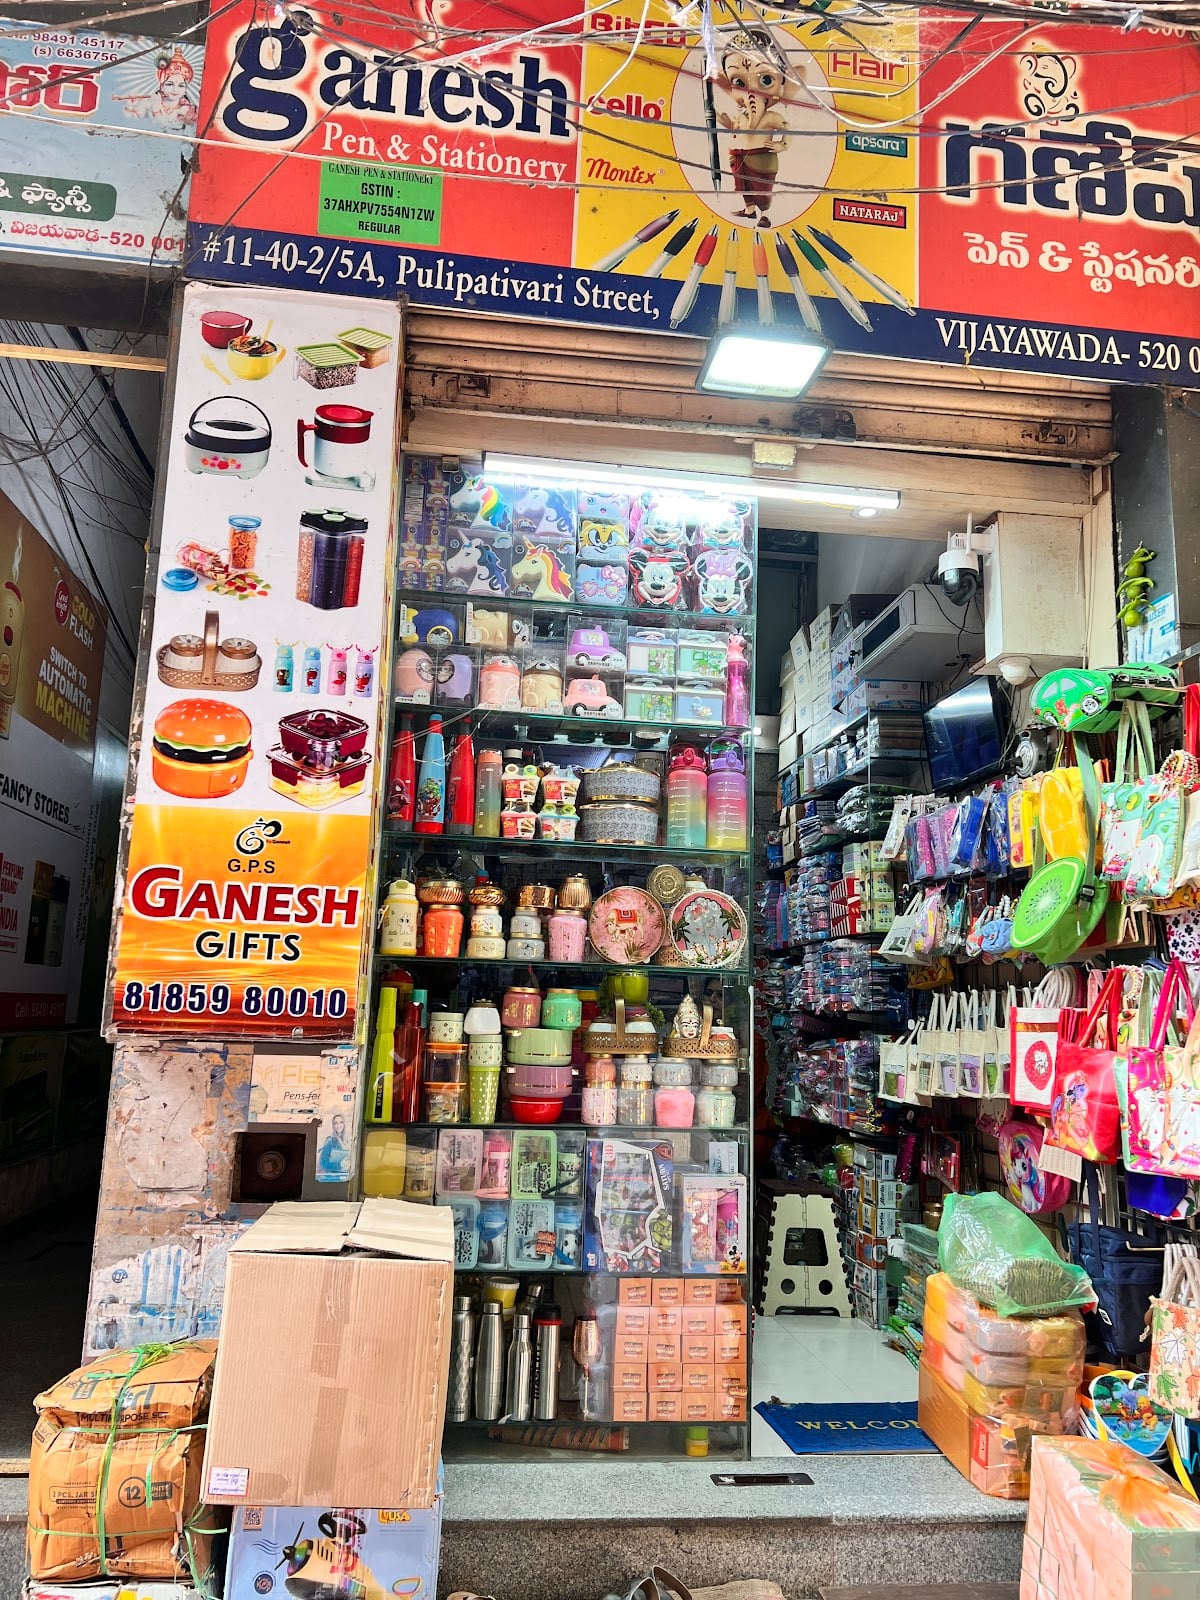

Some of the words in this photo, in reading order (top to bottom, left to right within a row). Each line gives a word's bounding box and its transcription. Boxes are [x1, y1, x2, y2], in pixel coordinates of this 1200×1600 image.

[32, 33, 75, 45] 98491
[80, 37, 125, 49] 45117
[57, 48, 118, 62] 6636756
[223, 10, 570, 141] ganesh
[832, 52, 904, 81] Flair
[587, 94, 662, 121] cello
[322, 121, 376, 157] Pen
[386, 134, 411, 161] &
[420, 134, 568, 184] Stationery
[852, 135, 900, 151] apsara
[361, 183, 394, 198] GSTIN
[358, 220, 401, 235] REGULAR
[839, 204, 899, 223] NATARAJ
[963, 230, 1030, 269] పెన్
[1038, 240, 1073, 273] &
[202, 231, 385, 289] #11-40-2/5A,
[396, 255, 564, 304] Pulipativari
[573, 277, 660, 320] Street,
[935, 317, 1131, 366] VIJAYAWADA-
[1138, 340, 1181, 371] 520
[71, 594, 96, 632] GOLD
[69, 618, 94, 651] FLASH
[50, 646, 77, 682] SWITCH
[77, 673, 88, 691] TO
[39, 659, 92, 717] AUTOMATIC
[35, 680, 90, 743] MACHINE
[34, 791, 70, 825] STORES
[227, 859, 276, 875] G.P.S
[132, 866, 360, 926] GANESH
[0, 906, 18, 932] NDIA
[195, 931, 301, 962] GIFTS
[124, 982, 231, 1013] 81859
[243, 986, 347, 1018] 80010
[283, 1091, 305, 1100] Pens
[124, 1485, 141, 1501] 12
